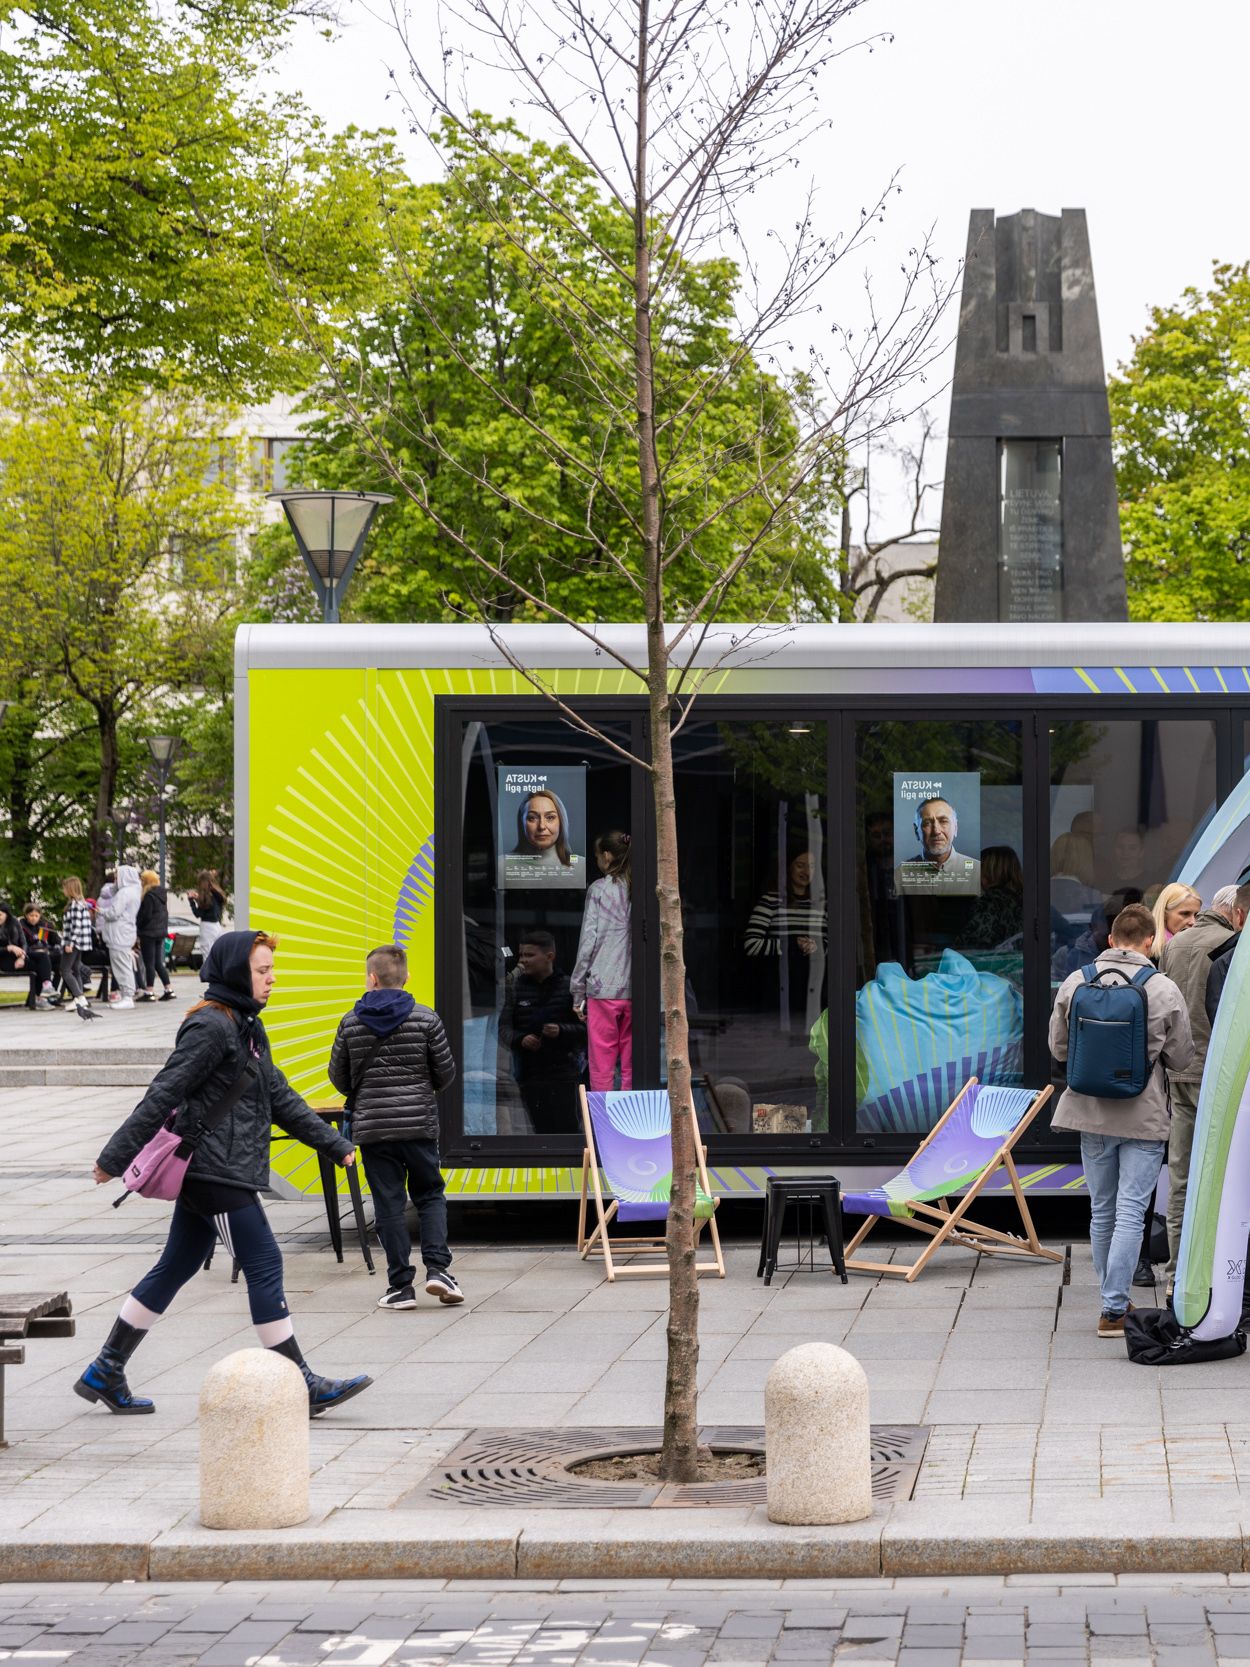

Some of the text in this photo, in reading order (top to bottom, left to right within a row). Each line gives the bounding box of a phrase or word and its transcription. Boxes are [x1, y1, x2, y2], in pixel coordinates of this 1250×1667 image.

[505, 783, 545, 793] ligą atgal
[901, 790, 940, 800] ligą atgal
